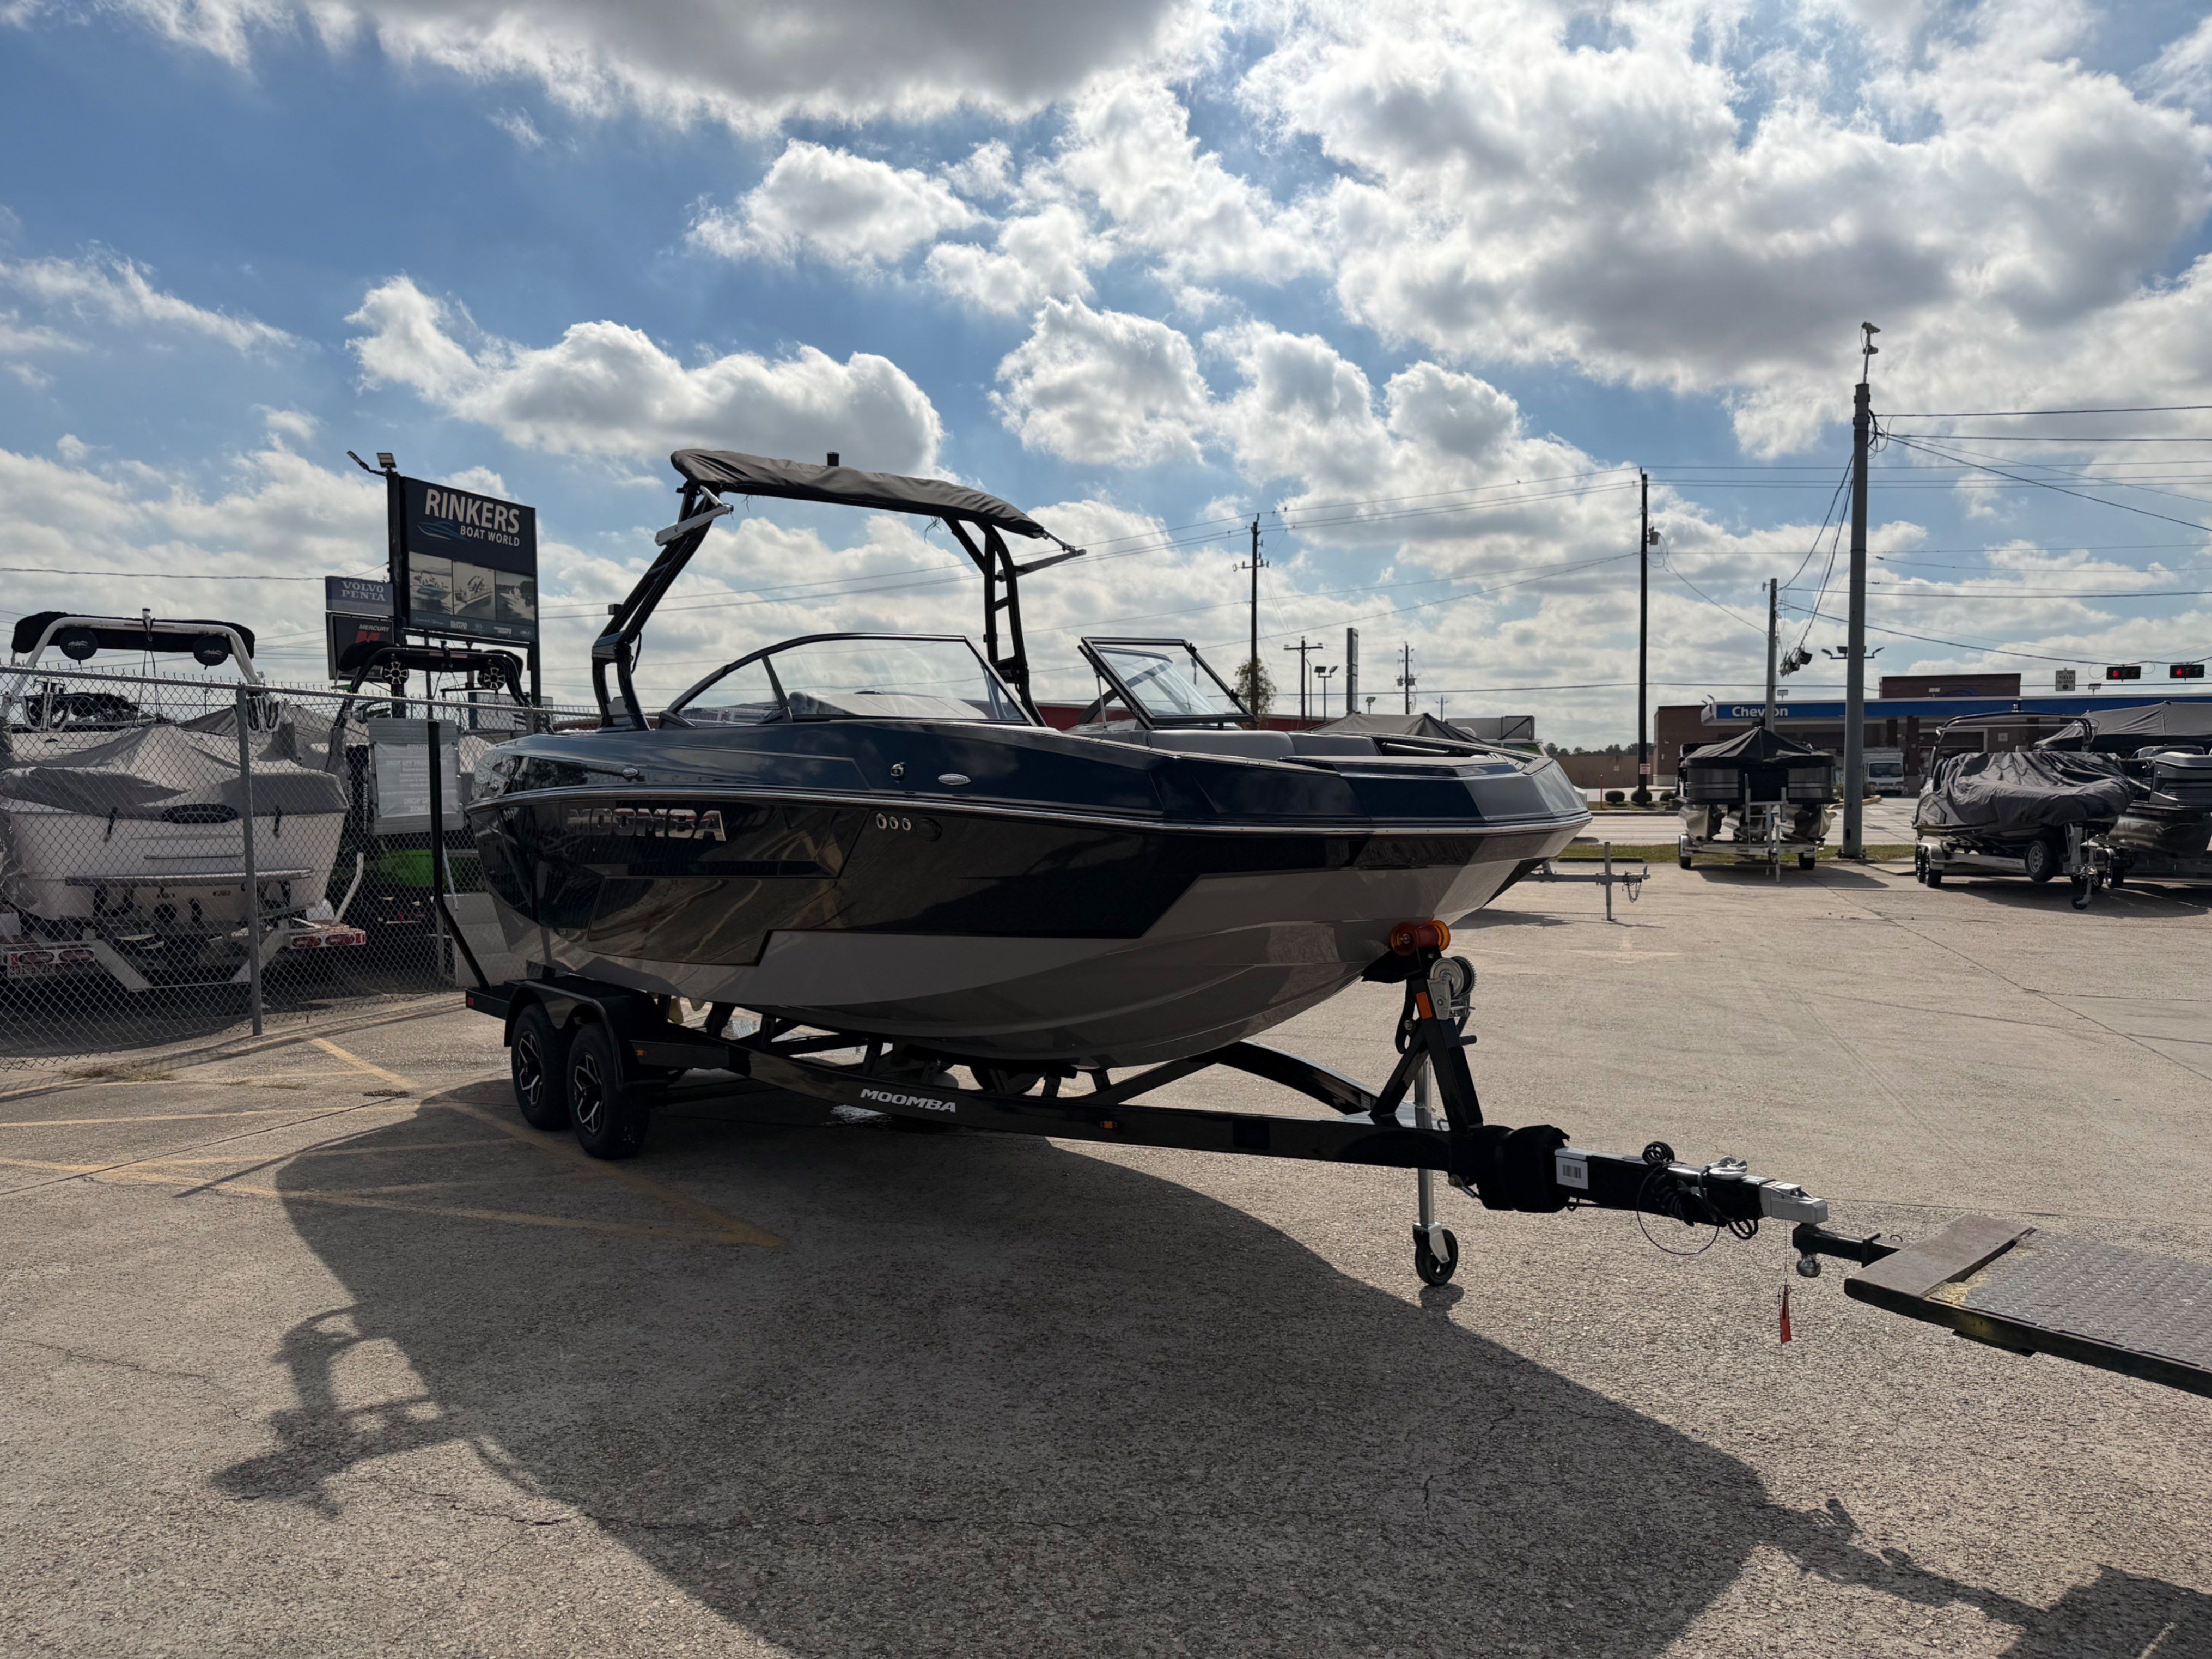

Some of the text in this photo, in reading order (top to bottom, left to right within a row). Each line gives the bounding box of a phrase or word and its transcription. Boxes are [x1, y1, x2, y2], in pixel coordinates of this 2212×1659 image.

[425, 489, 520, 534] RINKERS
[460, 525, 520, 546] BOAT WORLD
[341, 581, 384, 592] VOLVO
[341, 589, 386, 601] PENTA
[359, 624, 390, 632] MERCURY
[1732, 706, 1788, 717] Chevon
[568, 807, 726, 841] MOOMBA
[860, 1088, 956, 1113] MOOMBA
